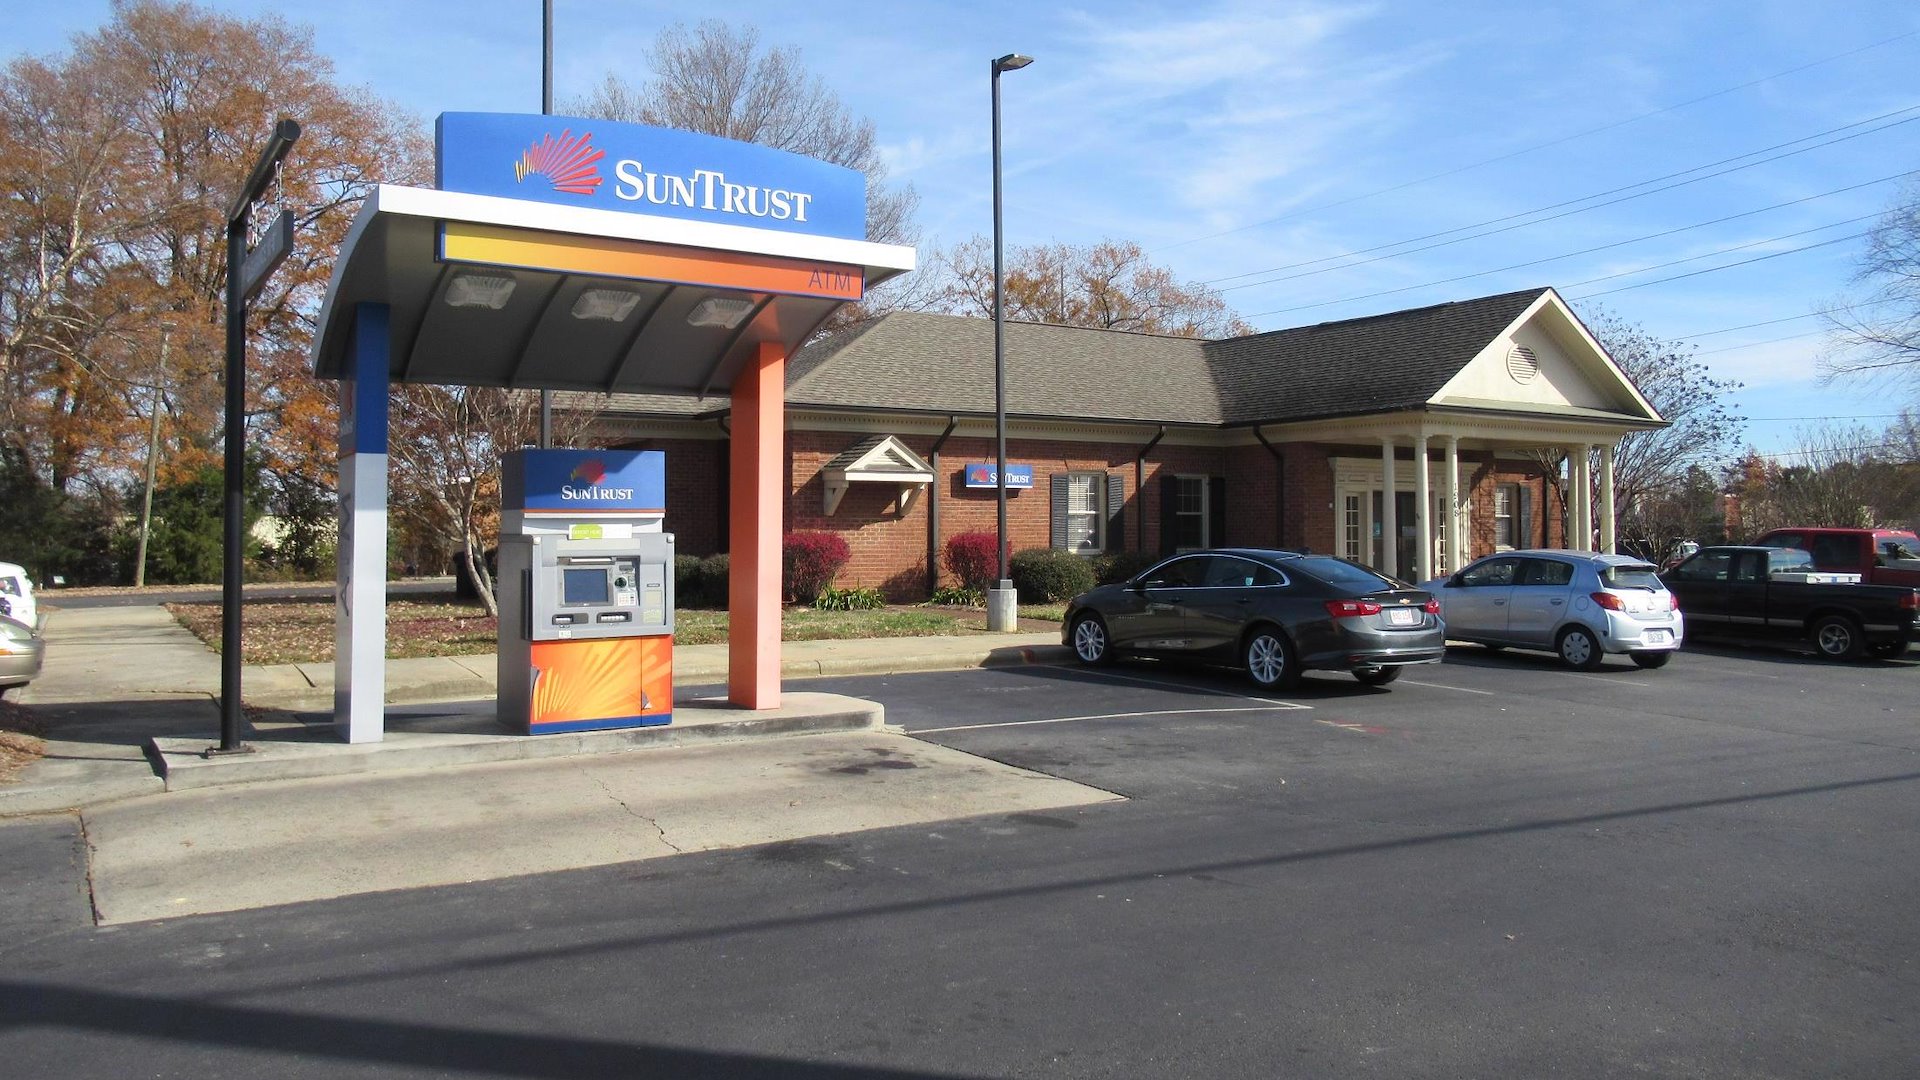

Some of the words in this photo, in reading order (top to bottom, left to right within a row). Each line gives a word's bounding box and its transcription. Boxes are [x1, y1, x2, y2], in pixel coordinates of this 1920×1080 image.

[615, 159, 812, 222] SUNTRUST
[809, 269, 851, 292] ATM
[990, 472, 1030, 484] STRUST
[561, 485, 634, 500] SUNTRUST
